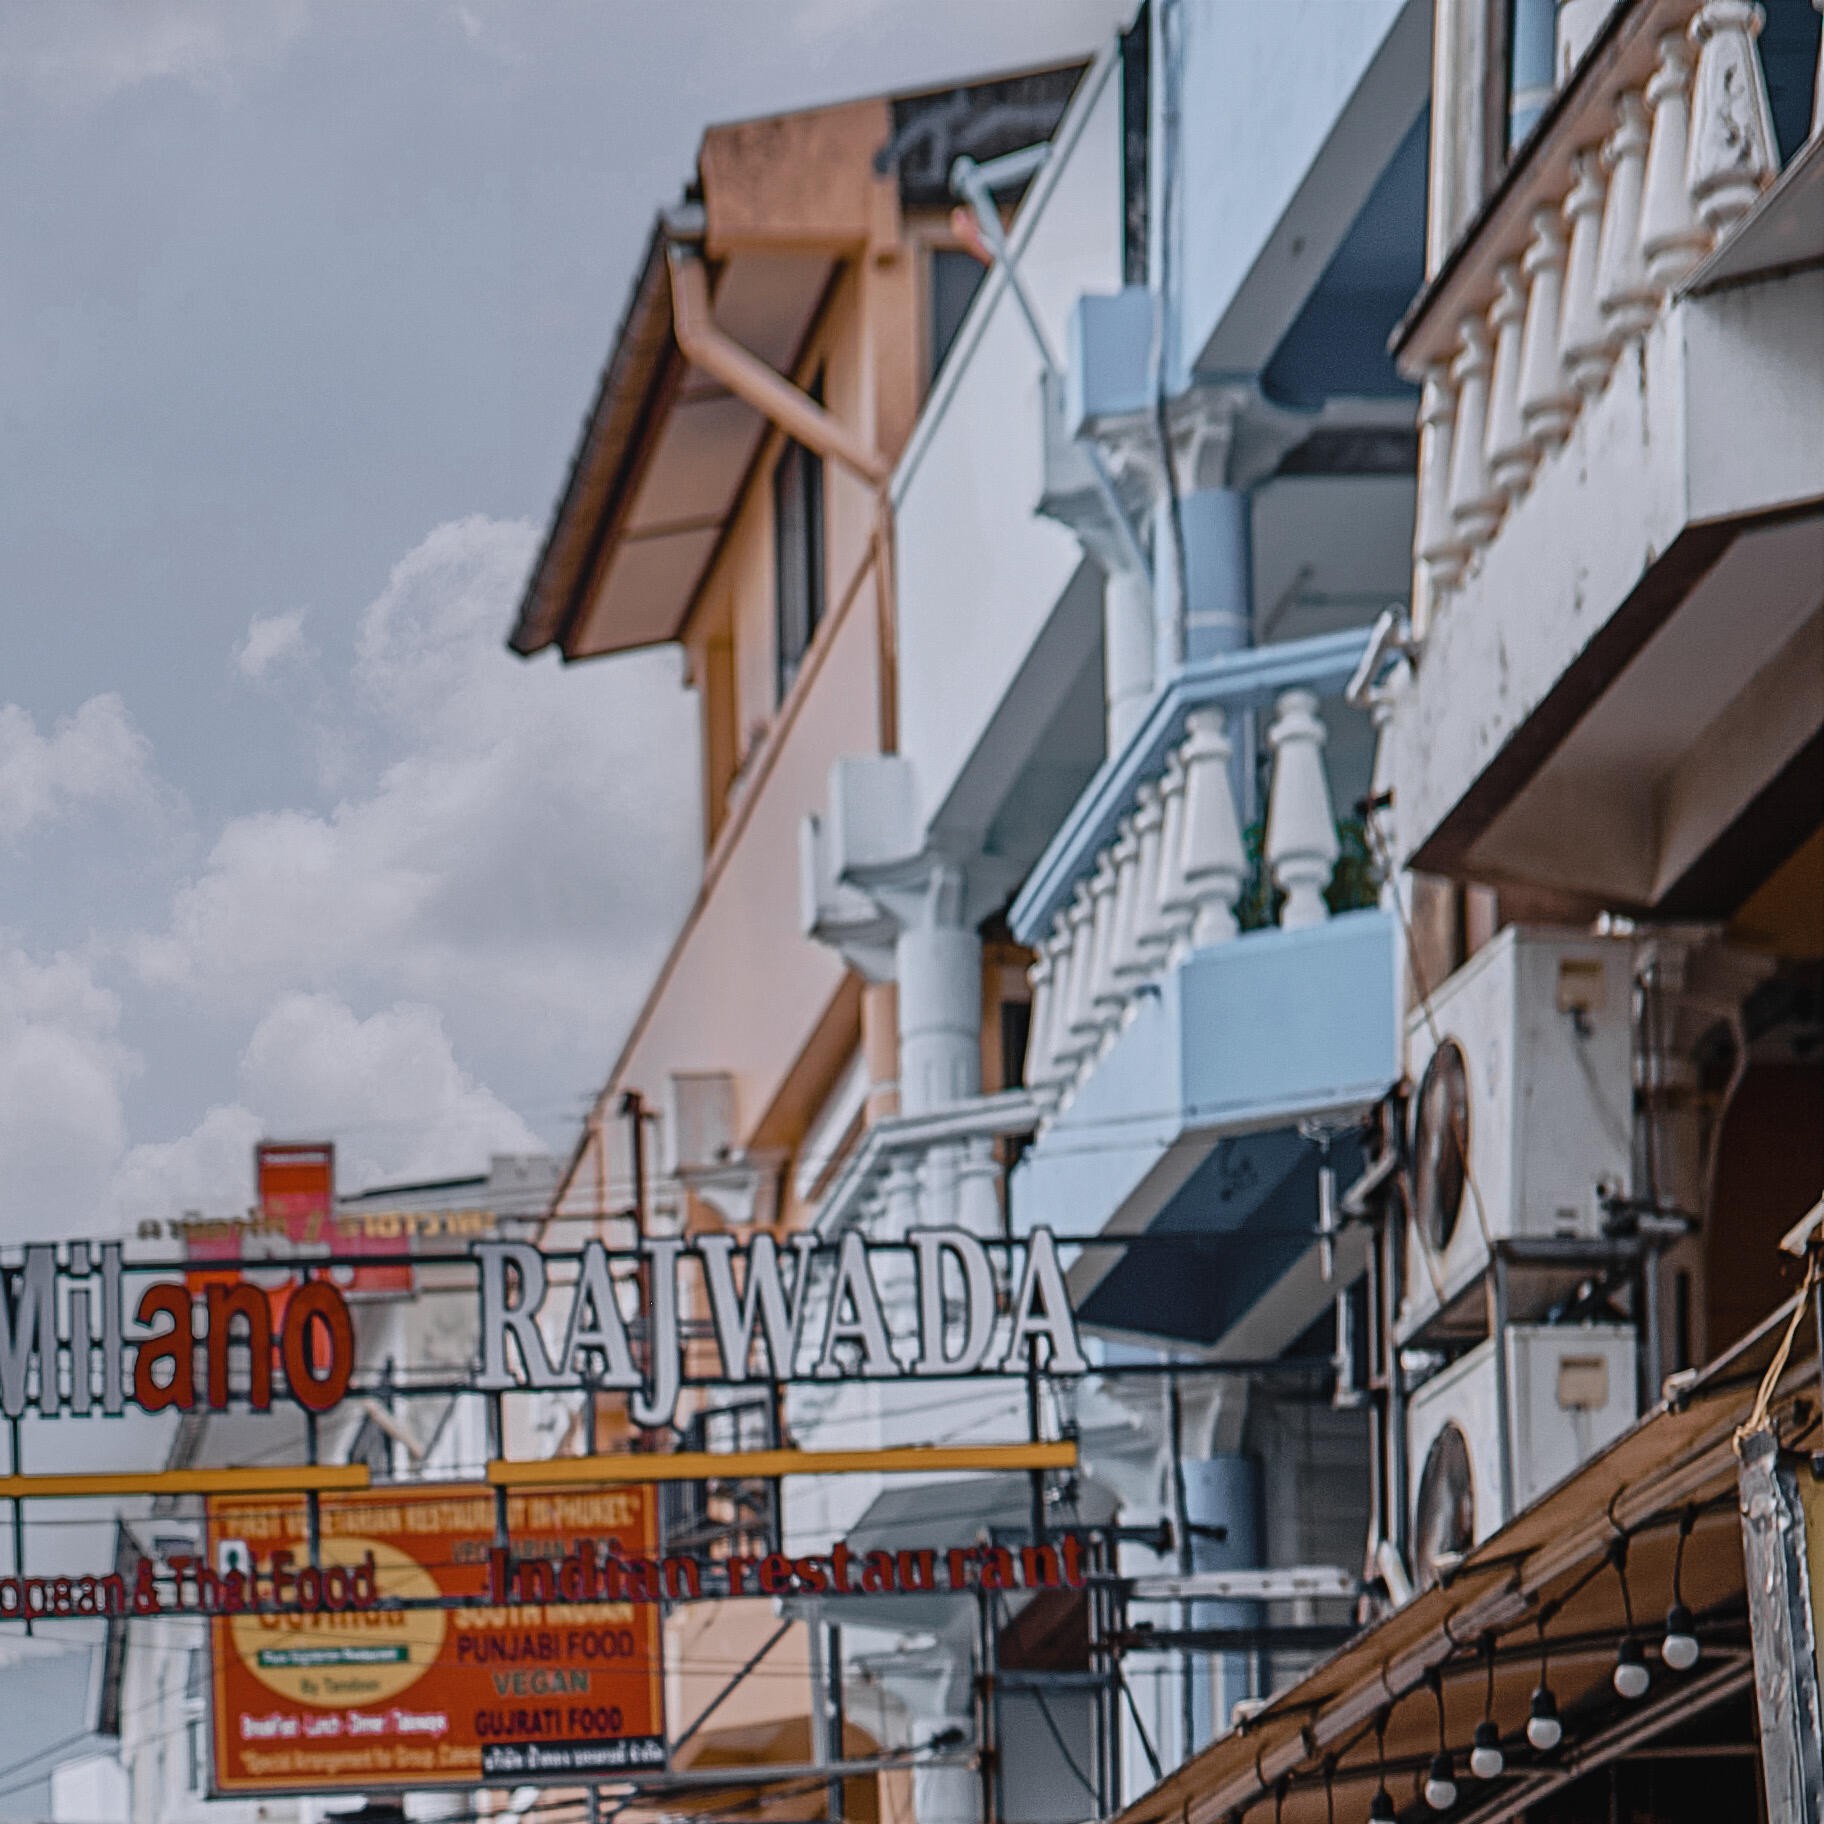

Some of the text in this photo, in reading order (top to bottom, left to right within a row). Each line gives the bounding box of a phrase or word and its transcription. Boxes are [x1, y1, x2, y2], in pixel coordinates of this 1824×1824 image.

[472, 1224, 1089, 1427] RAJWADA
[133, 1557, 158, 1615] &
[272, 1550, 376, 1611] Food
[489, 1537, 700, 1605] Indian
[728, 1534, 1088, 1594] restaurant
[457, 1629, 635, 1663] PUNJABI FOOD
[492, 1668, 590, 1697] VEGAN
[569, 1706, 623, 1733] FOOD
